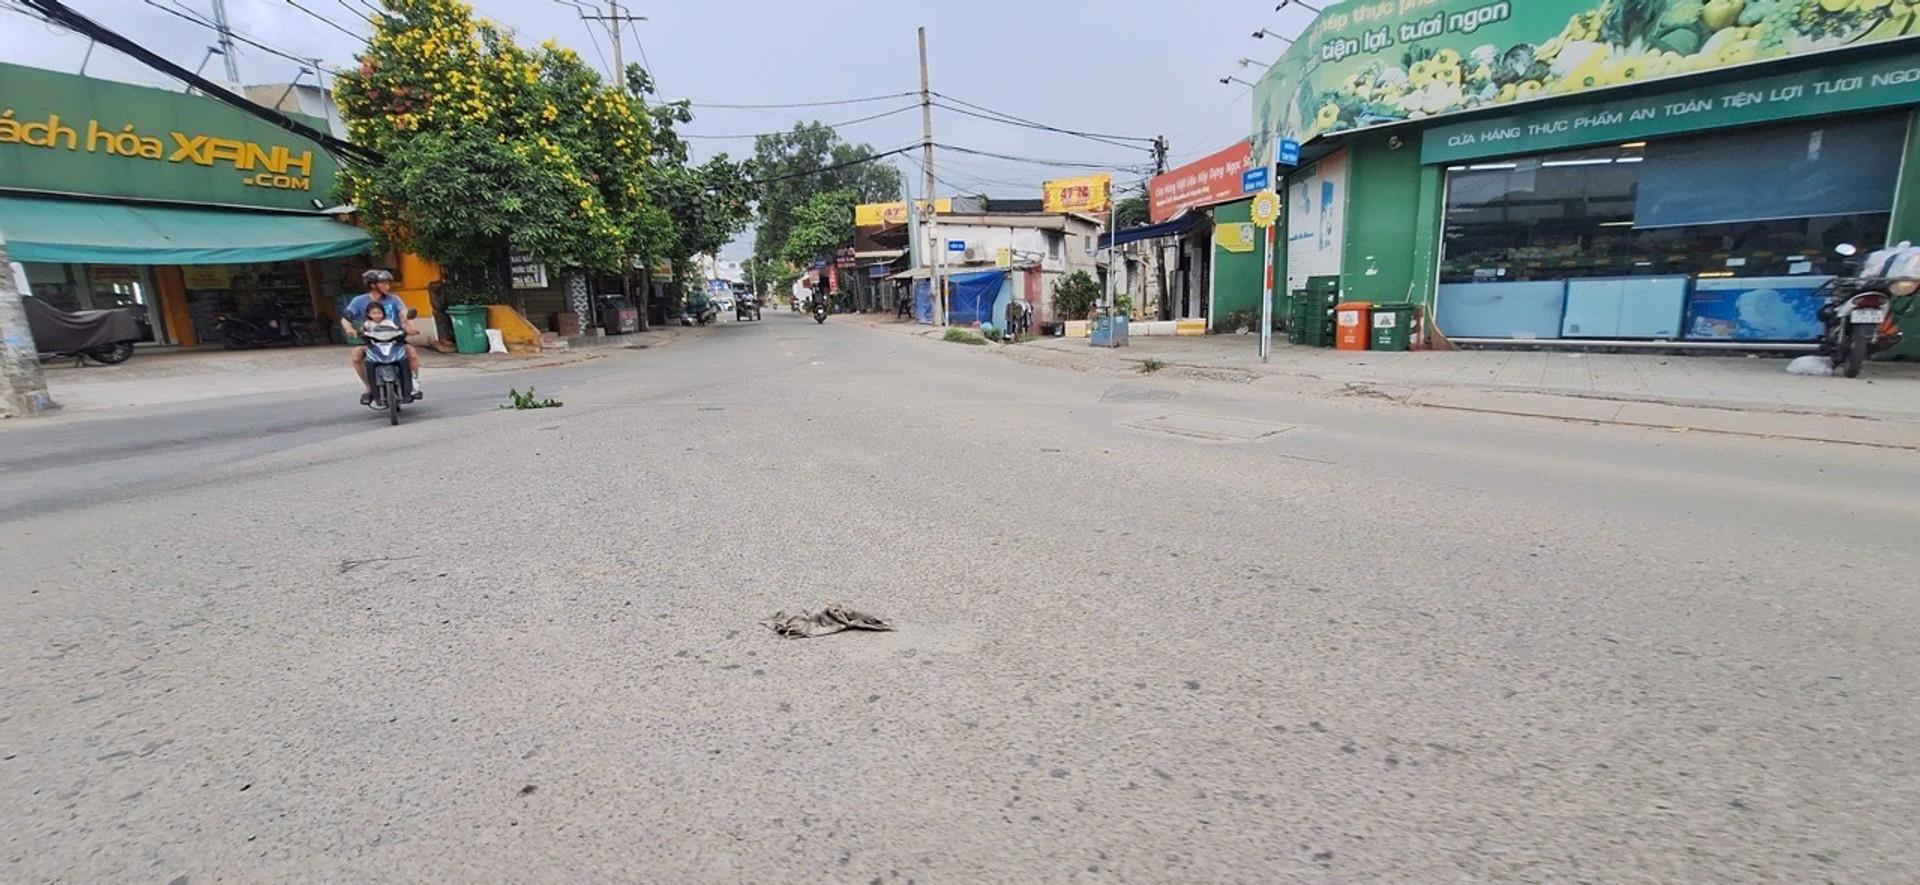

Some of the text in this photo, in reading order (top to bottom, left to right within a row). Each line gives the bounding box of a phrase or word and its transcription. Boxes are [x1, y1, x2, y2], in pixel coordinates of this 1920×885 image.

[1322, 38, 1359, 61] tiện
[1400, 12, 1443, 41] tươi
[1449, 2, 1508, 31] ngon
[1448, 132, 1475, 147] CỬA
[1480, 126, 1521, 142] HÀNG
[1527, 120, 1569, 136] THỰC
[1574, 110, 1622, 129] PHẨM
[1629, 107, 1655, 122] AN
[1663, 98, 1713, 116] TOÀN
[1721, 91, 1763, 108] TIỆN
[1769, 85, 1804, 102] LỢI
[1812, 77, 1863, 95] TƯƠI
[86, 119, 163, 160] hóa
[168, 131, 312, 177] XANH
[244, 173, 310, 191] .COM
